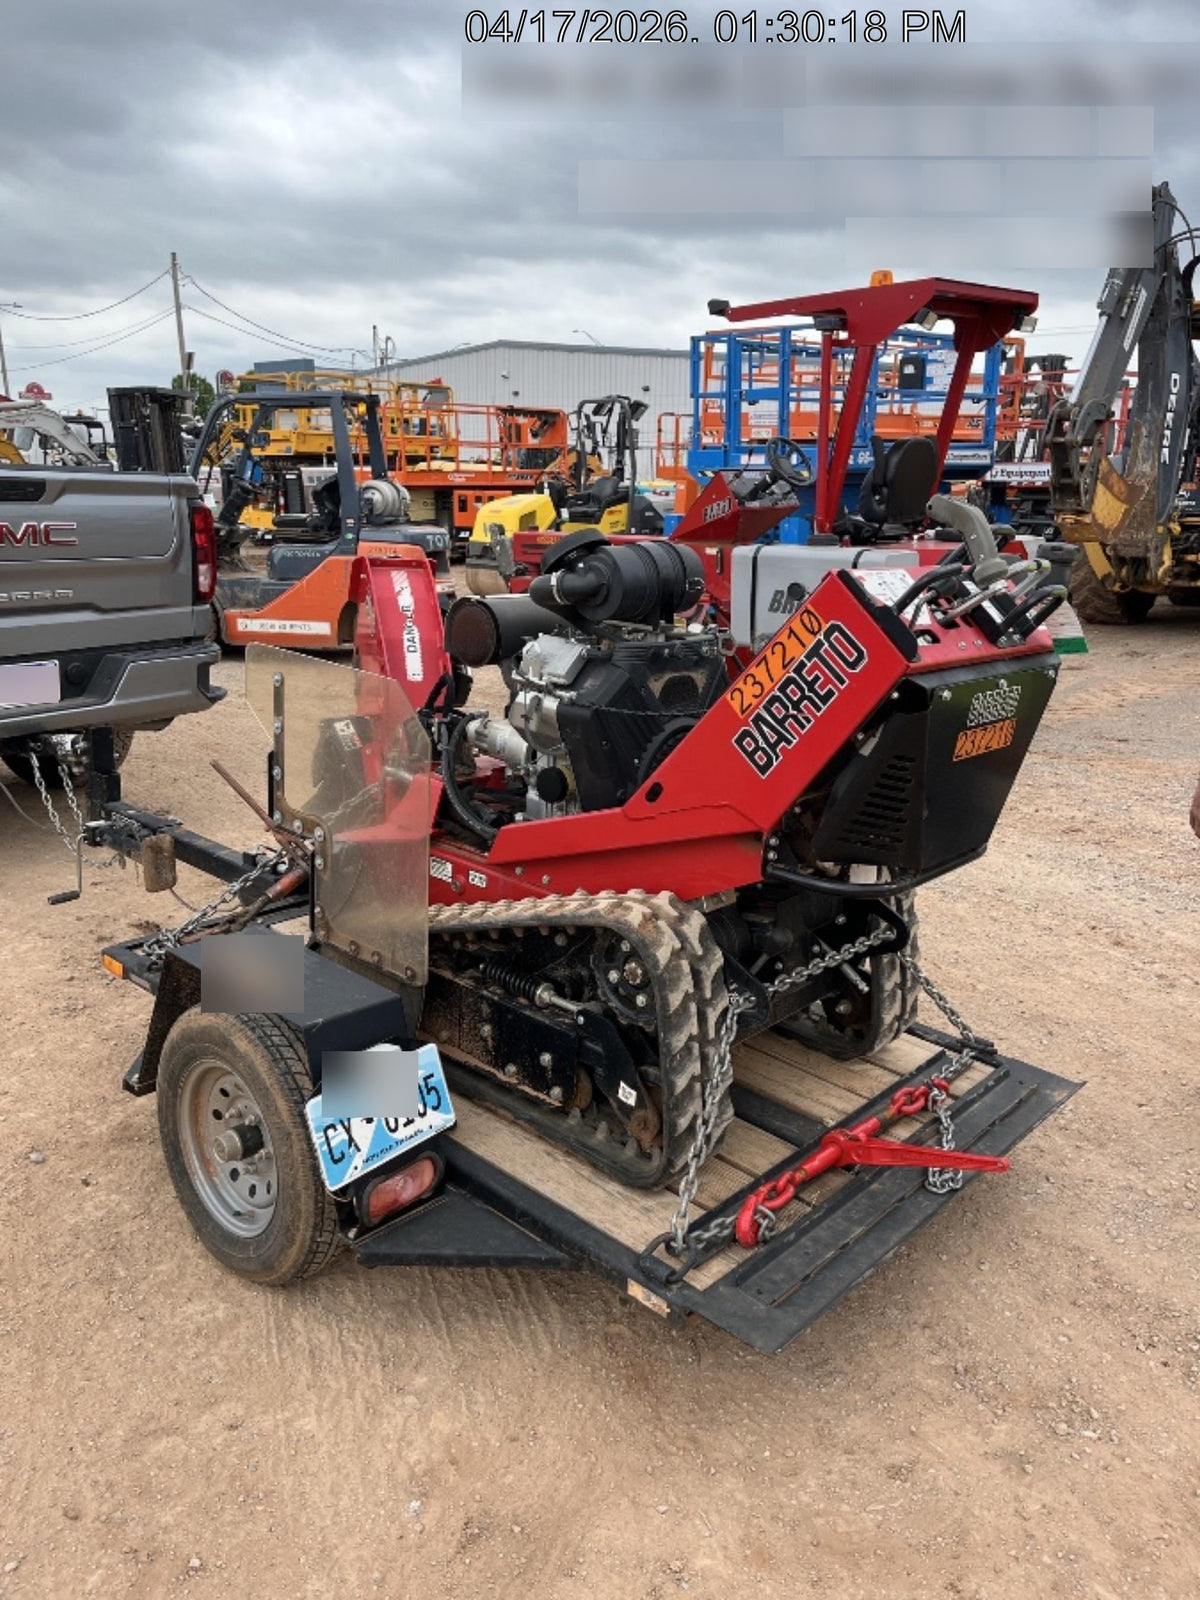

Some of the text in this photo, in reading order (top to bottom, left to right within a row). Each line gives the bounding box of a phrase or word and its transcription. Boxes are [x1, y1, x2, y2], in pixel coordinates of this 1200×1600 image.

[1161, 372, 1180, 465] DEERE
[730, 608, 822, 716] 237210
[732, 619, 868, 779] BARRETO
